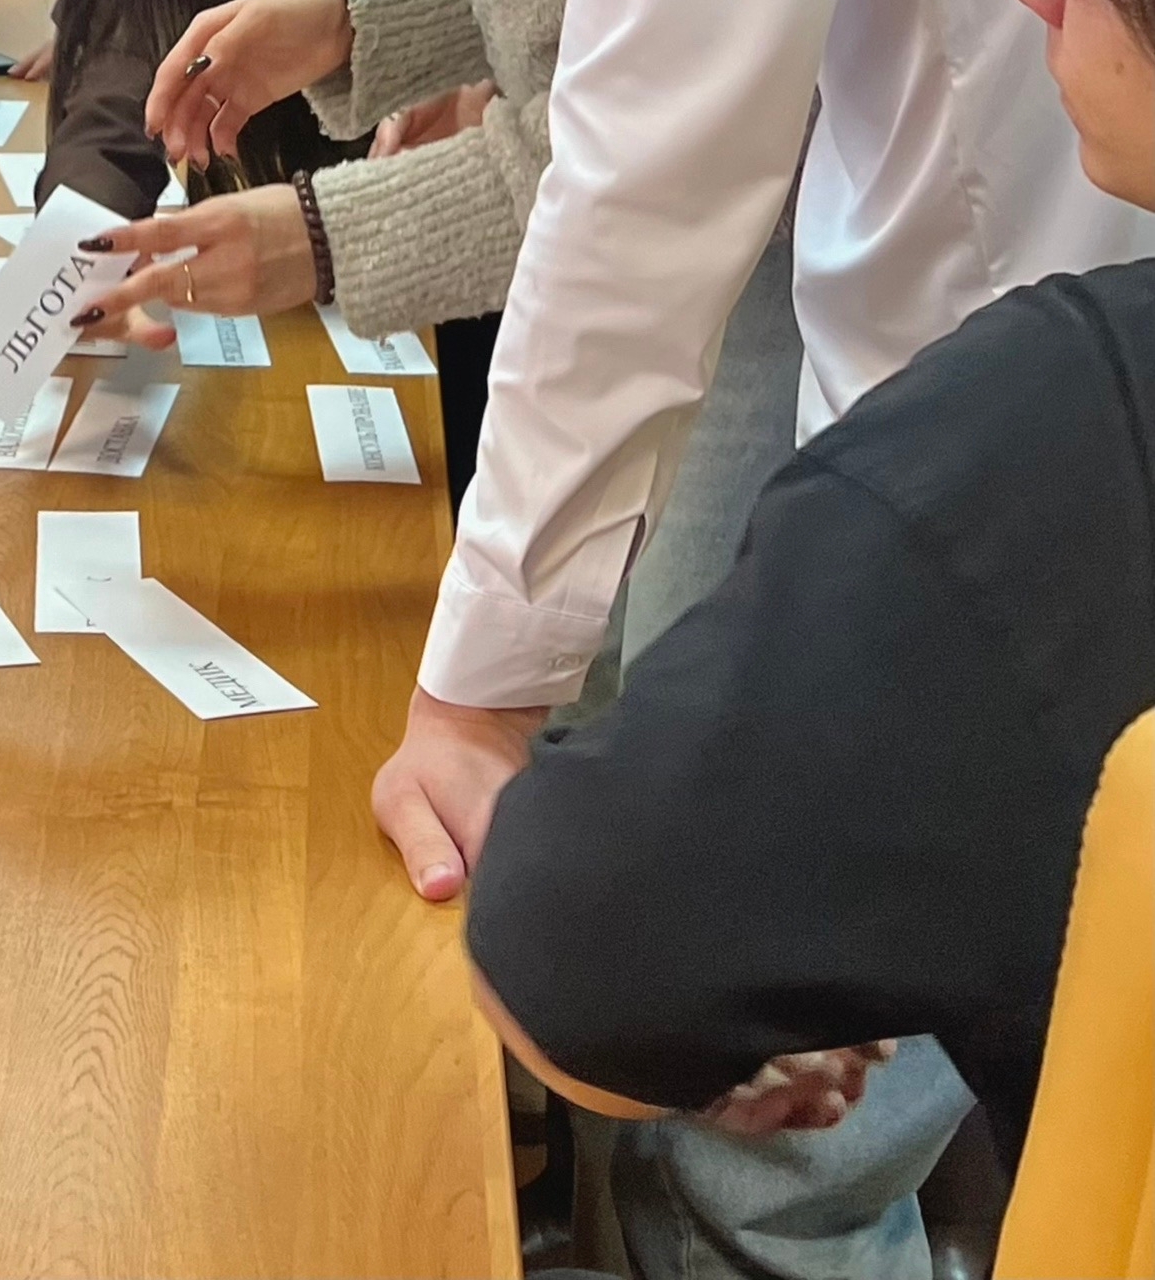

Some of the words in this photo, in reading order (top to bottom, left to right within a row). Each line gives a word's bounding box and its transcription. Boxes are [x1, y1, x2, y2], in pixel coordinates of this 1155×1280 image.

[0, 255, 95, 373] ЛЬГОТА
[96, 415, 140, 464] ДОСТАВКА
[189, 661, 265, 708] МЕДИК
